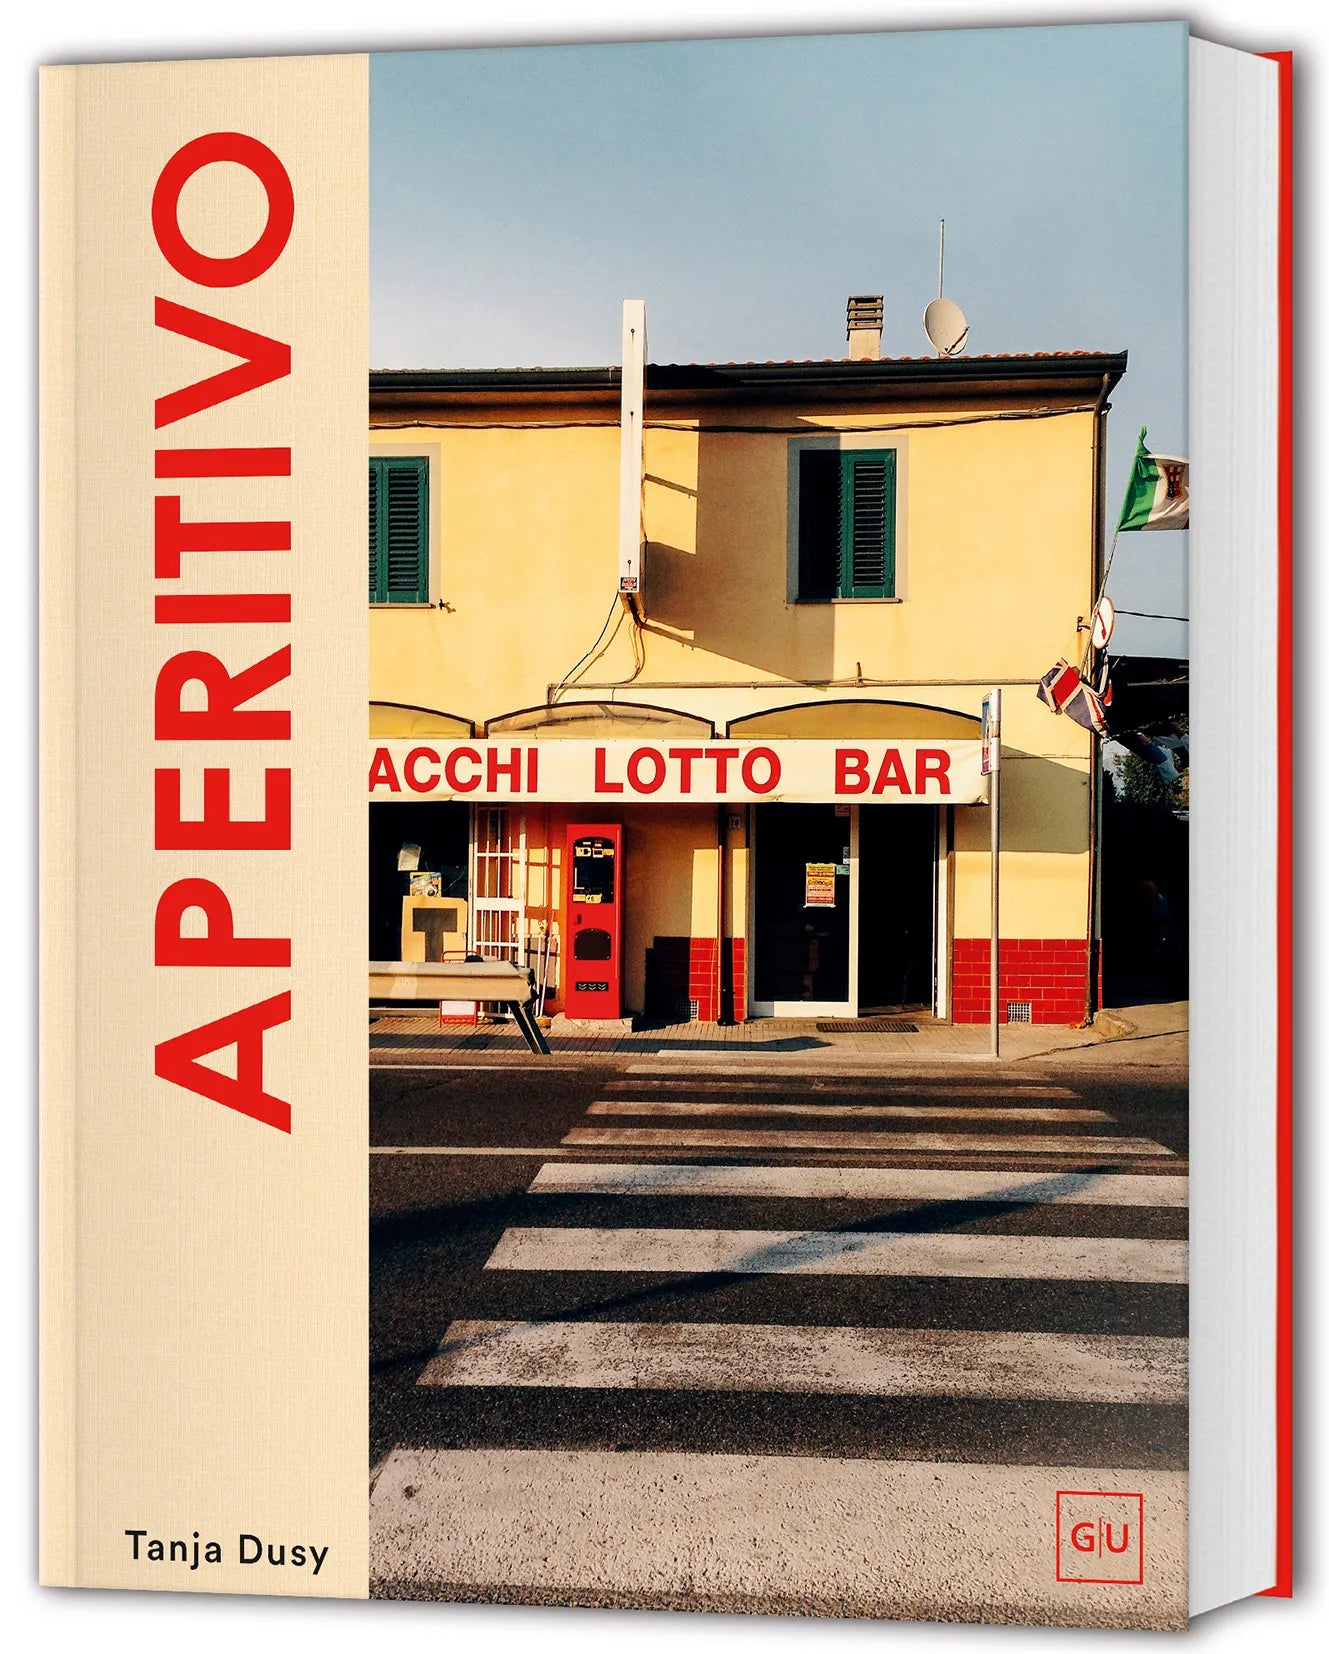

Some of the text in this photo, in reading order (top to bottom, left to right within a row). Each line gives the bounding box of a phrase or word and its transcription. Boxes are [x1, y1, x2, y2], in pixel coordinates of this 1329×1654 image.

[152, 131, 294, 1134] APERITIVO
[369, 747, 951, 795] ACCHI LOTTO BAR
[125, 1529, 329, 1576] Tanja Dusy
